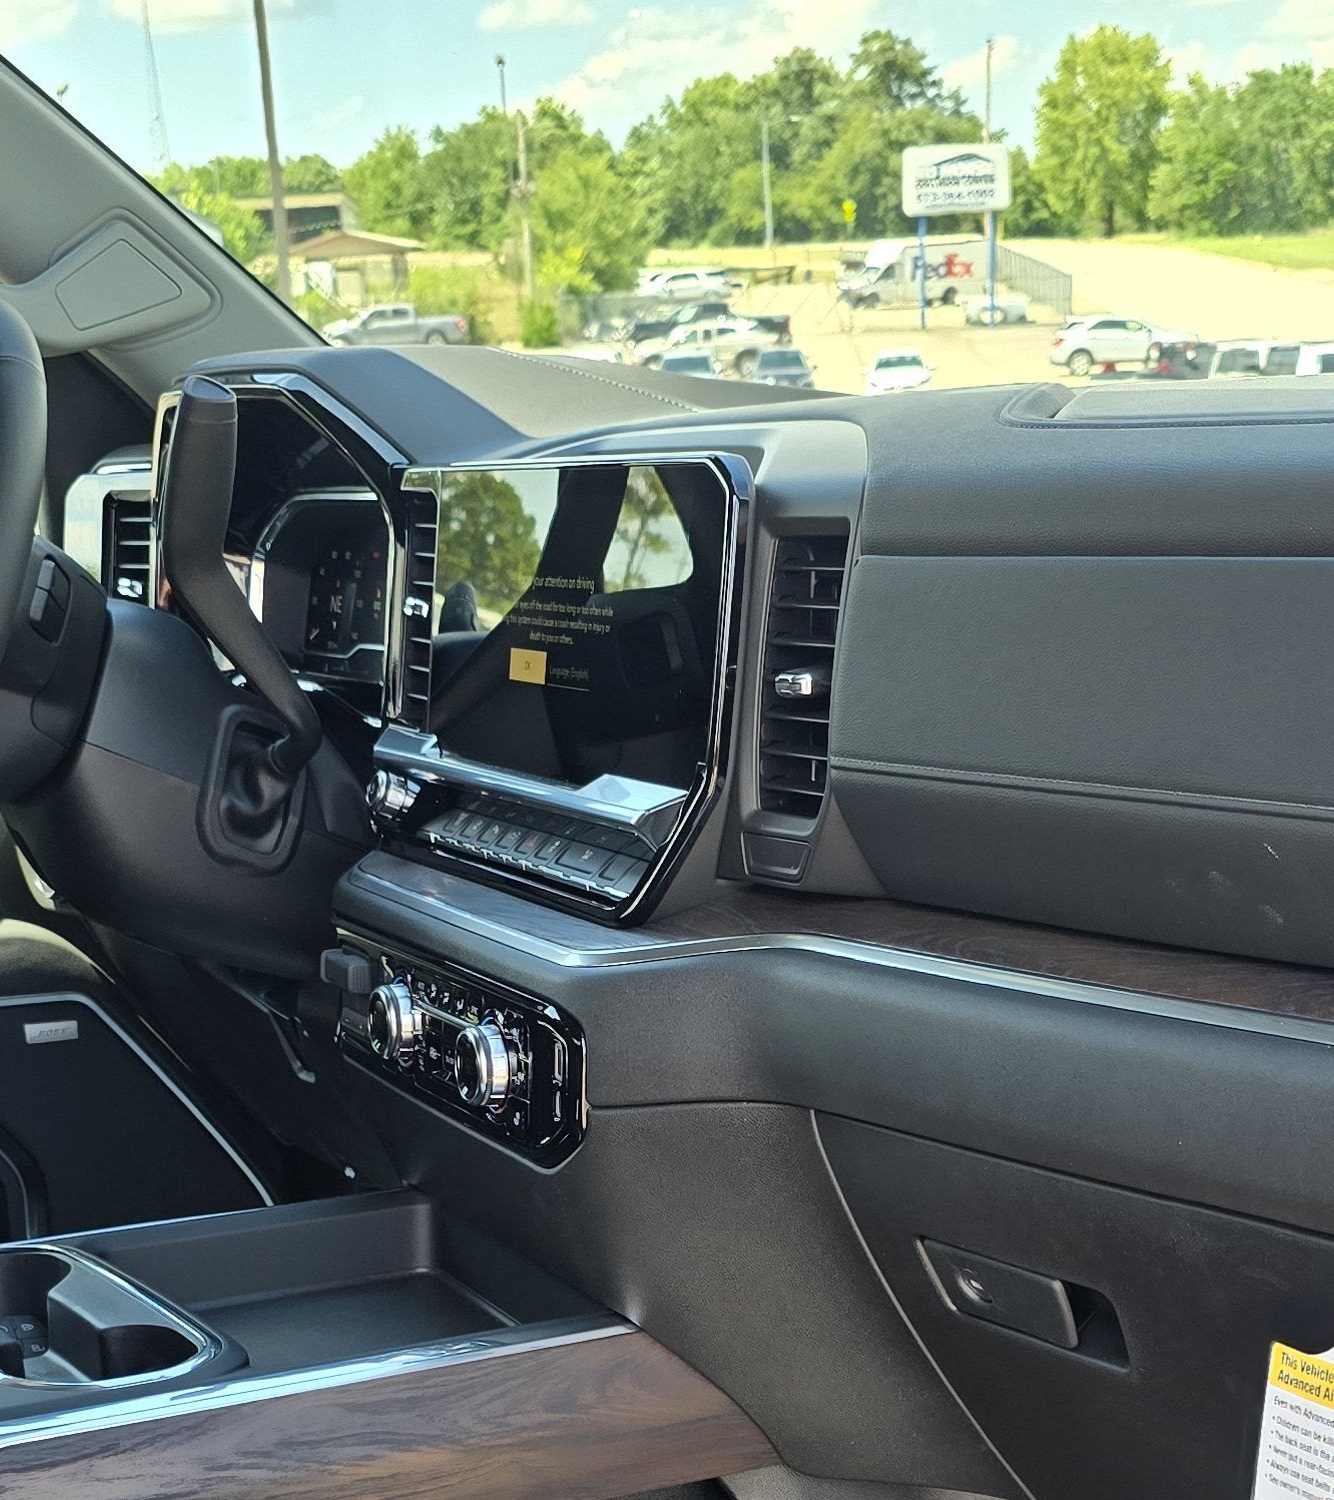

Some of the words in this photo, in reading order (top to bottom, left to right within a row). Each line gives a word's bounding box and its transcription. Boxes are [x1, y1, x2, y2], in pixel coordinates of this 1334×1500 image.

[576, 577, 594, 594] driving
[1281, 1352, 1298, 1370] This
[1300, 1359, 1334, 1384] Vehicle
[1277, 1370, 1322, 1398] Advanced
[1277, 1416, 1300, 1433] Children
[1300, 1428, 1312, 1438] can
[1313, 1431, 1322, 1441] be
